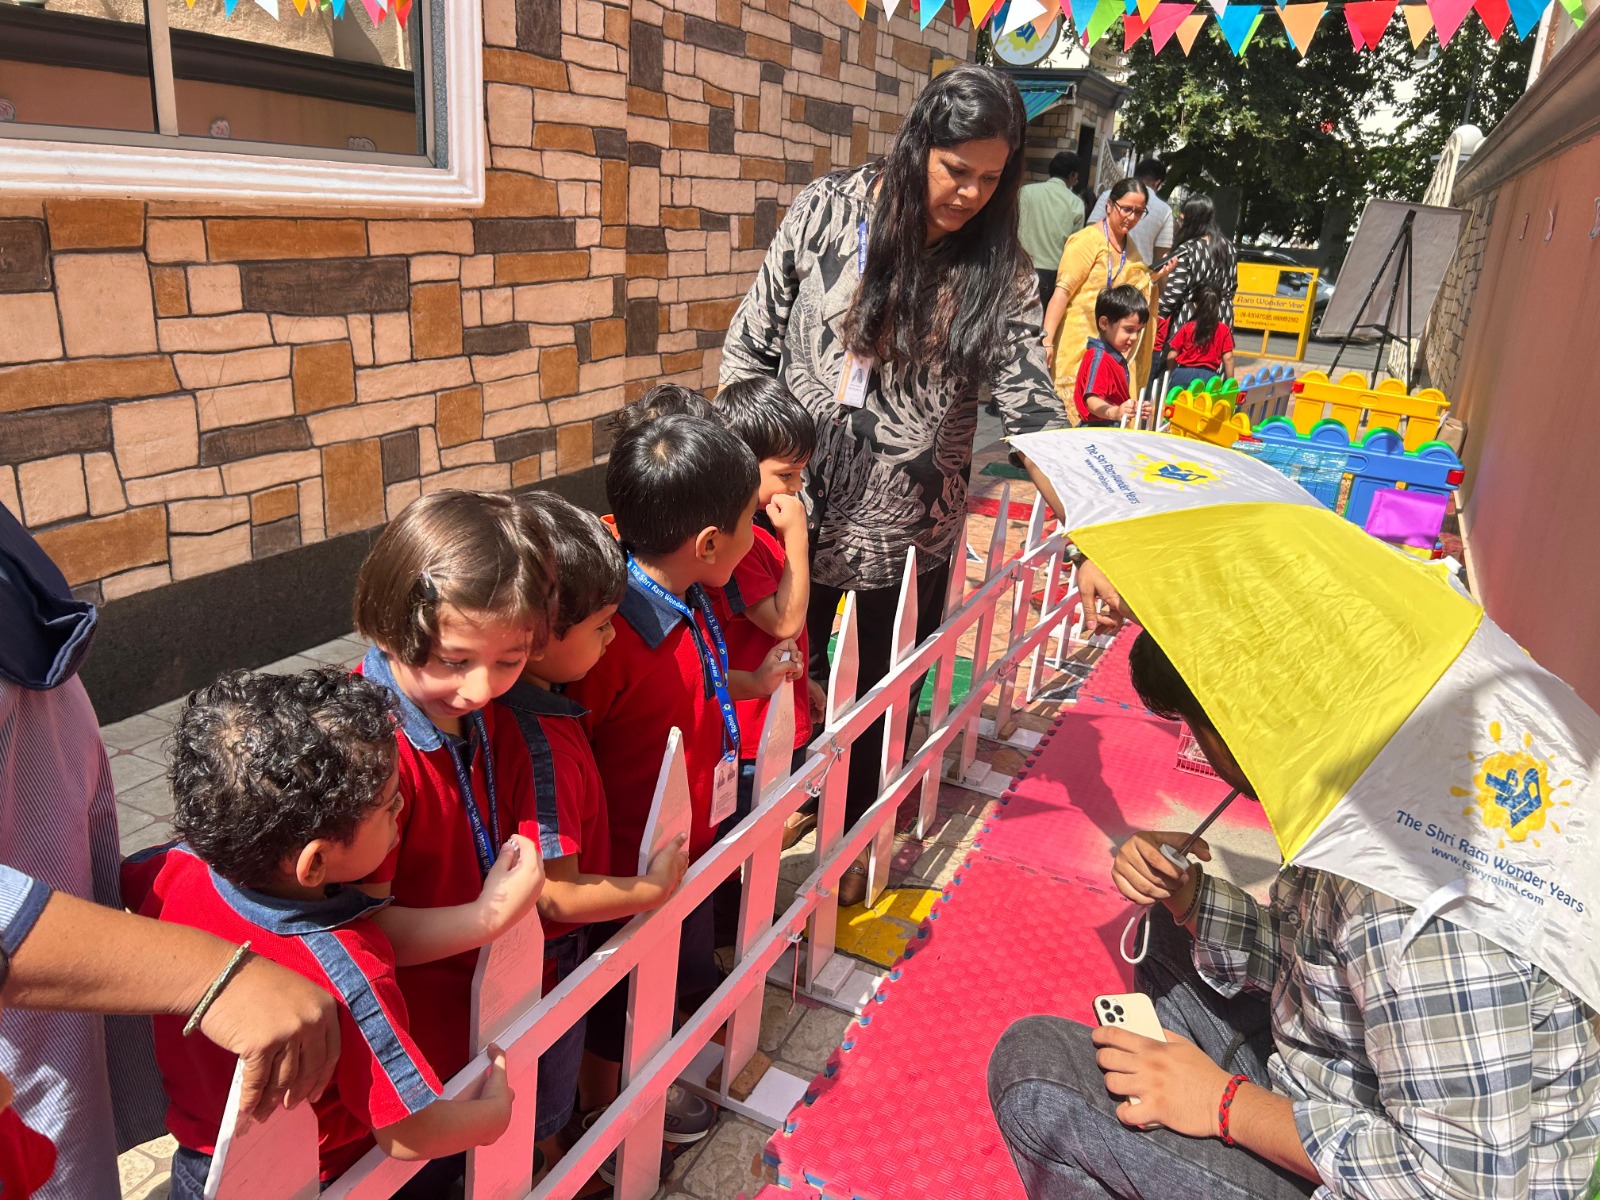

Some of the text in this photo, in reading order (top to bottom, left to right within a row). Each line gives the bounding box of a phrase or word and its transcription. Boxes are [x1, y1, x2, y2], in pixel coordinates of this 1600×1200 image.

[1237, 296, 1255, 304] Ram
[1256, 297, 1288, 307] Wonder
[1085, 444, 1098, 456] The
[1094, 454, 1111, 465] Shri
[1102, 463, 1117, 476] Ram
[1124, 491, 1140, 504] Years
[631, 565, 687, 611] The Shri Ram Wonder
[725, 714, 738, 734] Rohini
[476, 831, 488, 857] Wonder
[1396, 809, 1585, 913] The Shri Ram Wonder Years
[1431, 846, 1544, 906] www.tswyrohini.com
